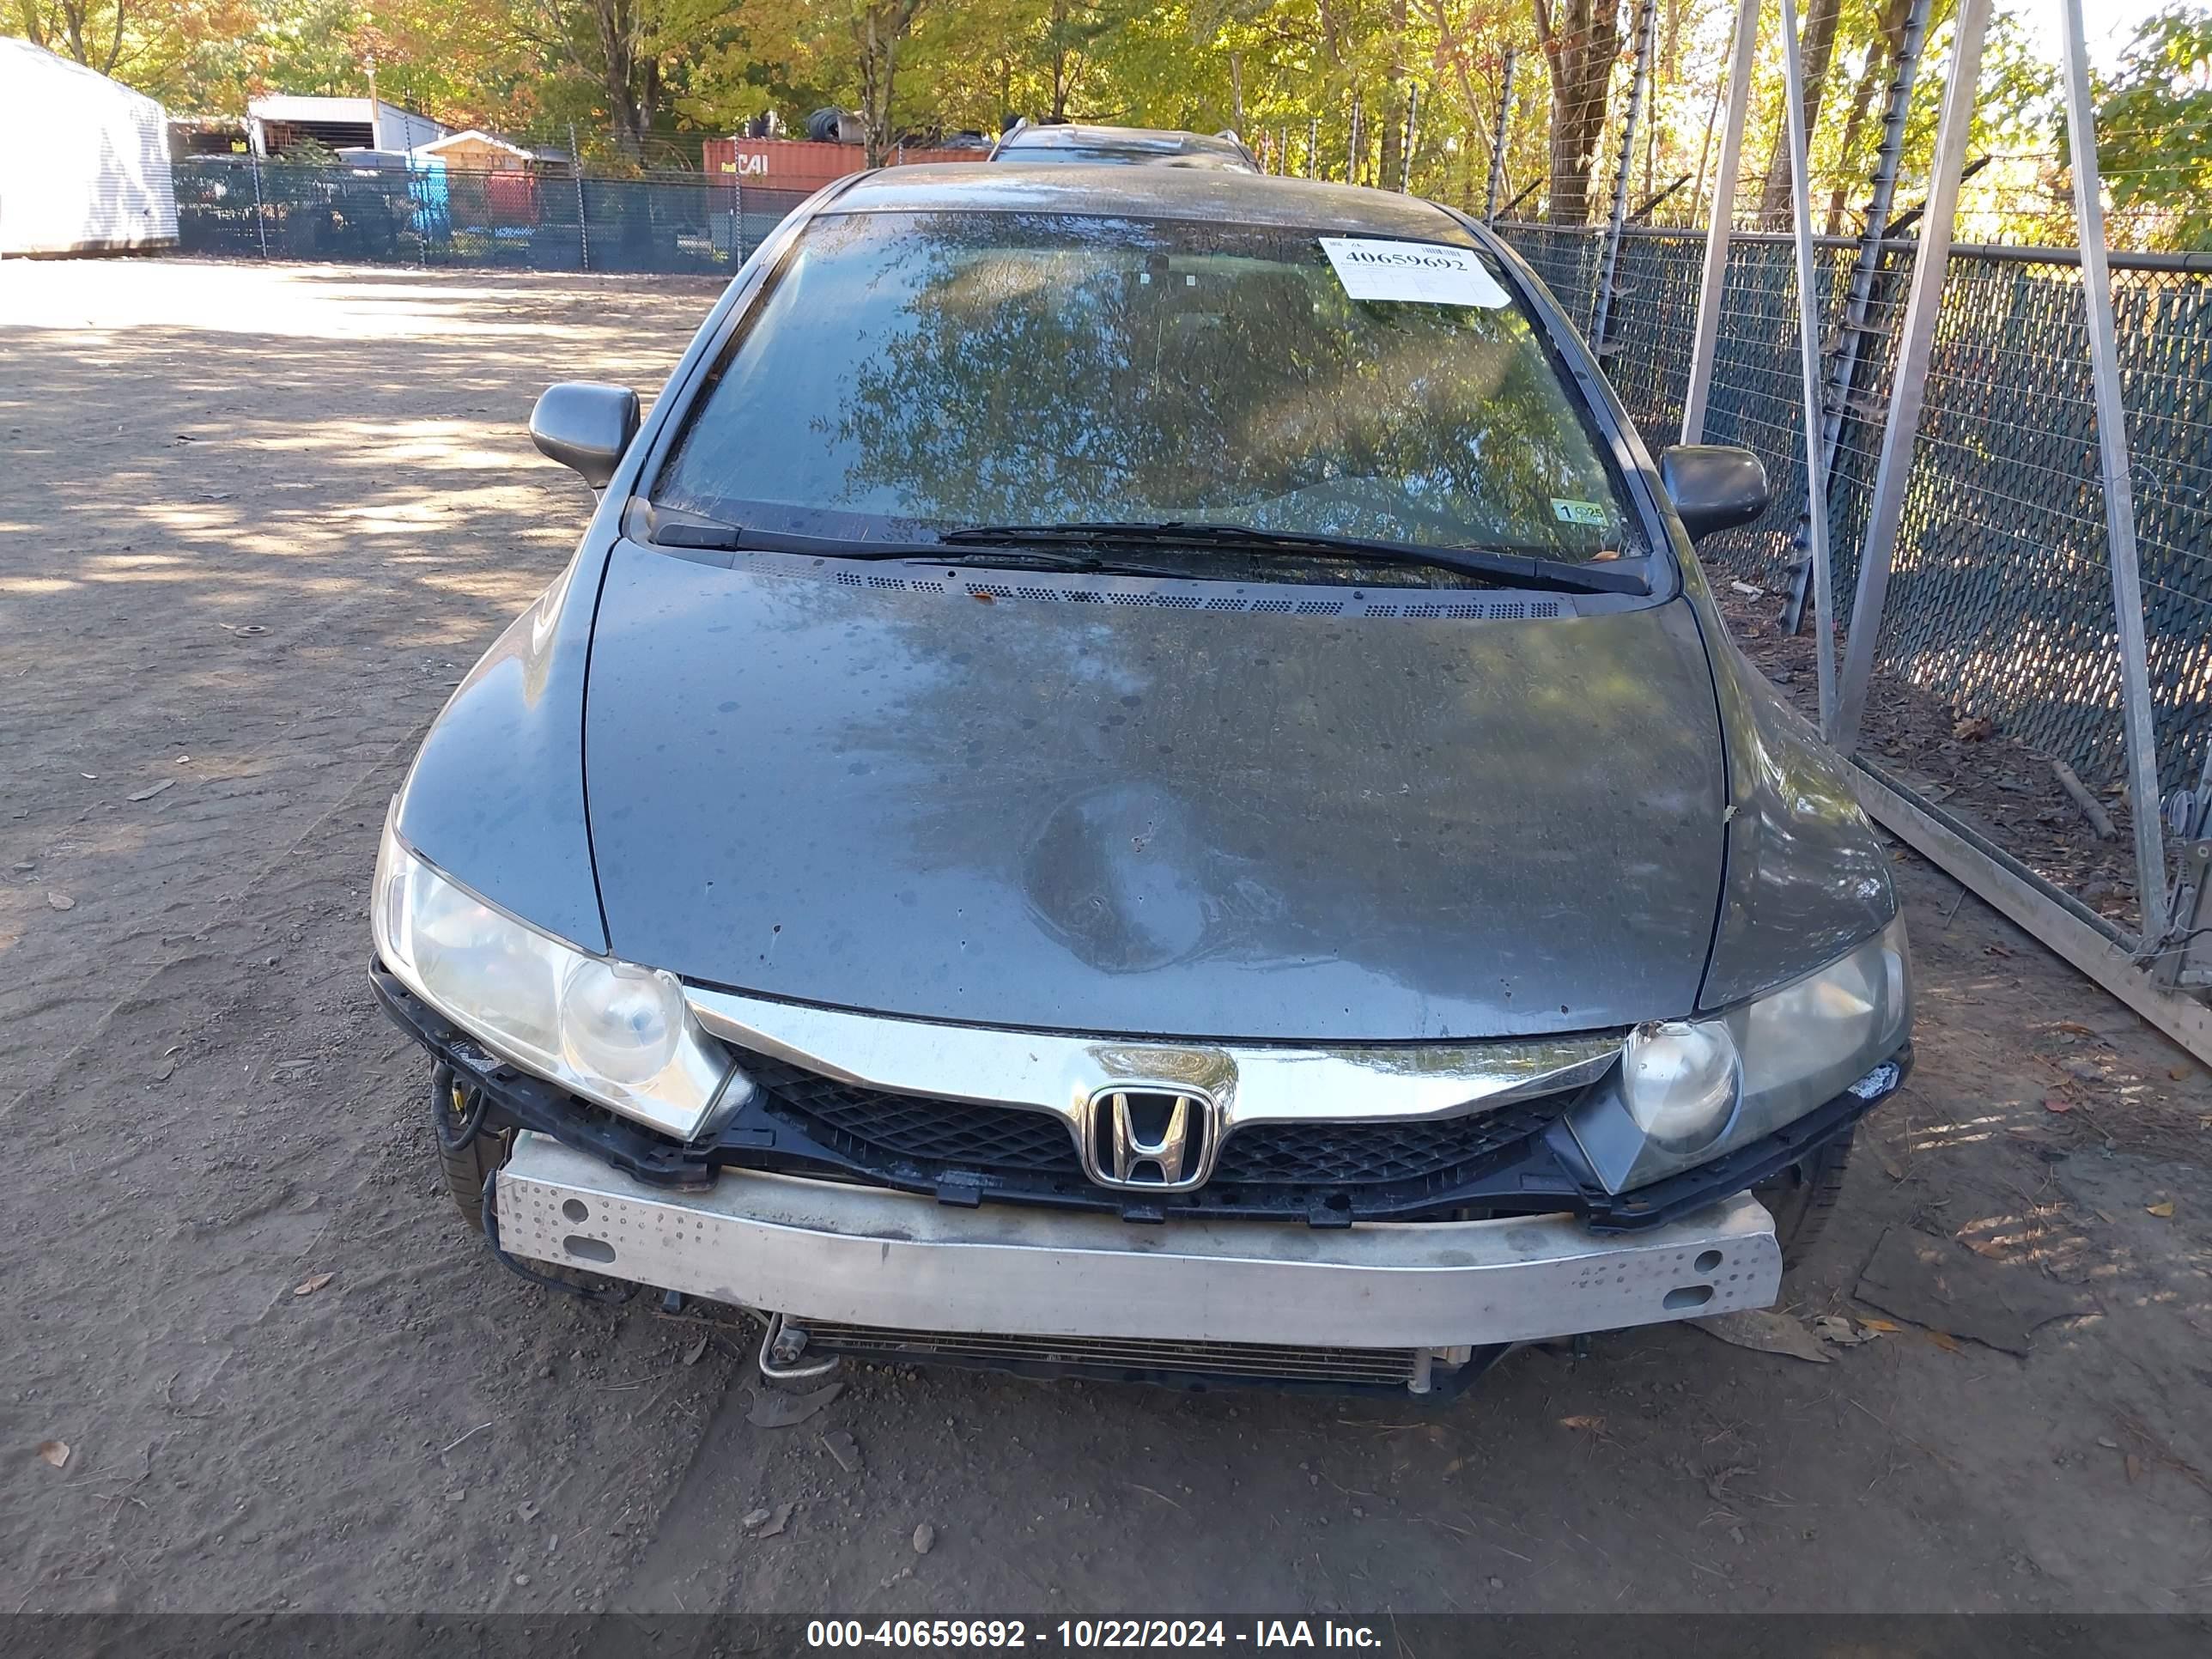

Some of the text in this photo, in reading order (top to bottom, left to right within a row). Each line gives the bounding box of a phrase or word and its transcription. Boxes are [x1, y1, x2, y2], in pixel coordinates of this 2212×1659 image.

[738, 154, 769, 177] CAI
[1346, 252, 1468, 271] 40659692
[1560, 505, 1604, 519] 1 25
